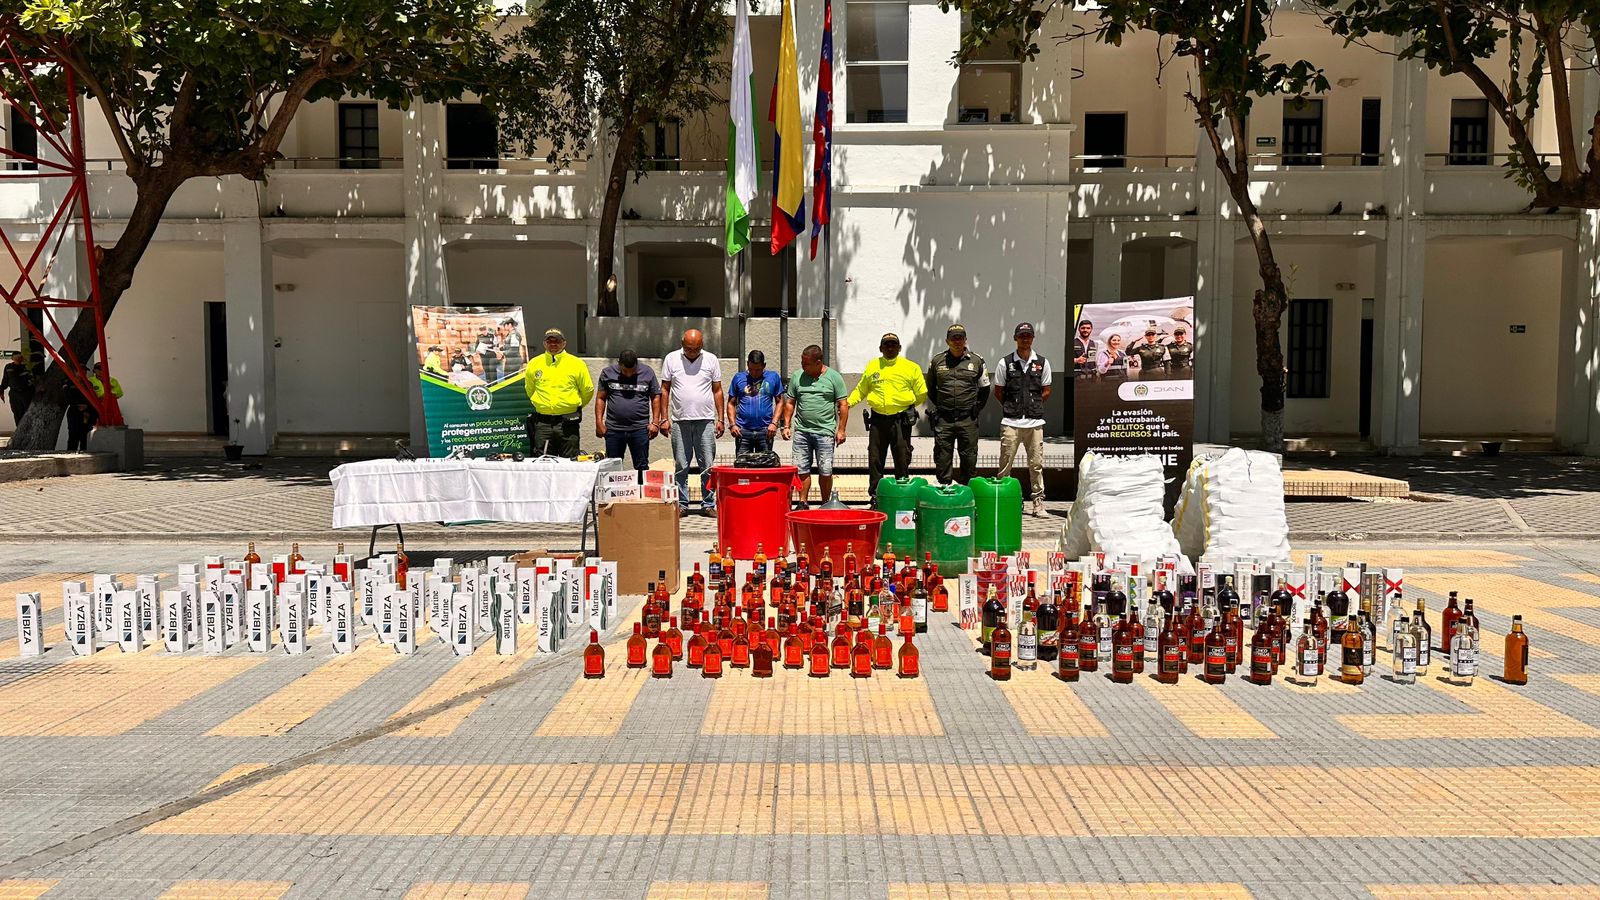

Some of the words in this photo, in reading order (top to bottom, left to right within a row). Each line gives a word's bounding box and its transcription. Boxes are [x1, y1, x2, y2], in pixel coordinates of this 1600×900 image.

[441, 427, 492, 438] protegemos
[503, 417, 521, 426] legal,
[1087, 431, 1109, 439] roban
[1161, 430, 1180, 438] país.
[452, 443, 490, 452] progreso
[478, 433, 516, 441] económicos
[365, 581, 373, 606] IBIZA
[481, 590, 489, 618] Marine
[522, 579, 530, 605] IBIZA
[571, 579, 579, 605] IBIZA
[76, 605, 85, 634] IBIZA
[105, 603, 113, 631] IBIZA
[123, 602, 131, 631] IBIZA
[143, 593, 152, 621] IBIZA
[169, 602, 177, 631] IBIZA
[225, 604, 234, 631] IBIZA
[252, 602, 260, 631] IBIZA
[288, 604, 296, 632] IBIZA
[337, 603, 346, 632] IBIZA
[383, 595, 391, 623] IBIZA
[399, 603, 407, 632] IBIZA
[441, 599, 449, 628] Marine
[458, 604, 467, 633] IBIZA
[540, 606, 548, 636] Marine
[22, 615, 32, 644] IBIZA
[207, 613, 215, 641] IBIZA
[503, 609, 511, 639] Marine
